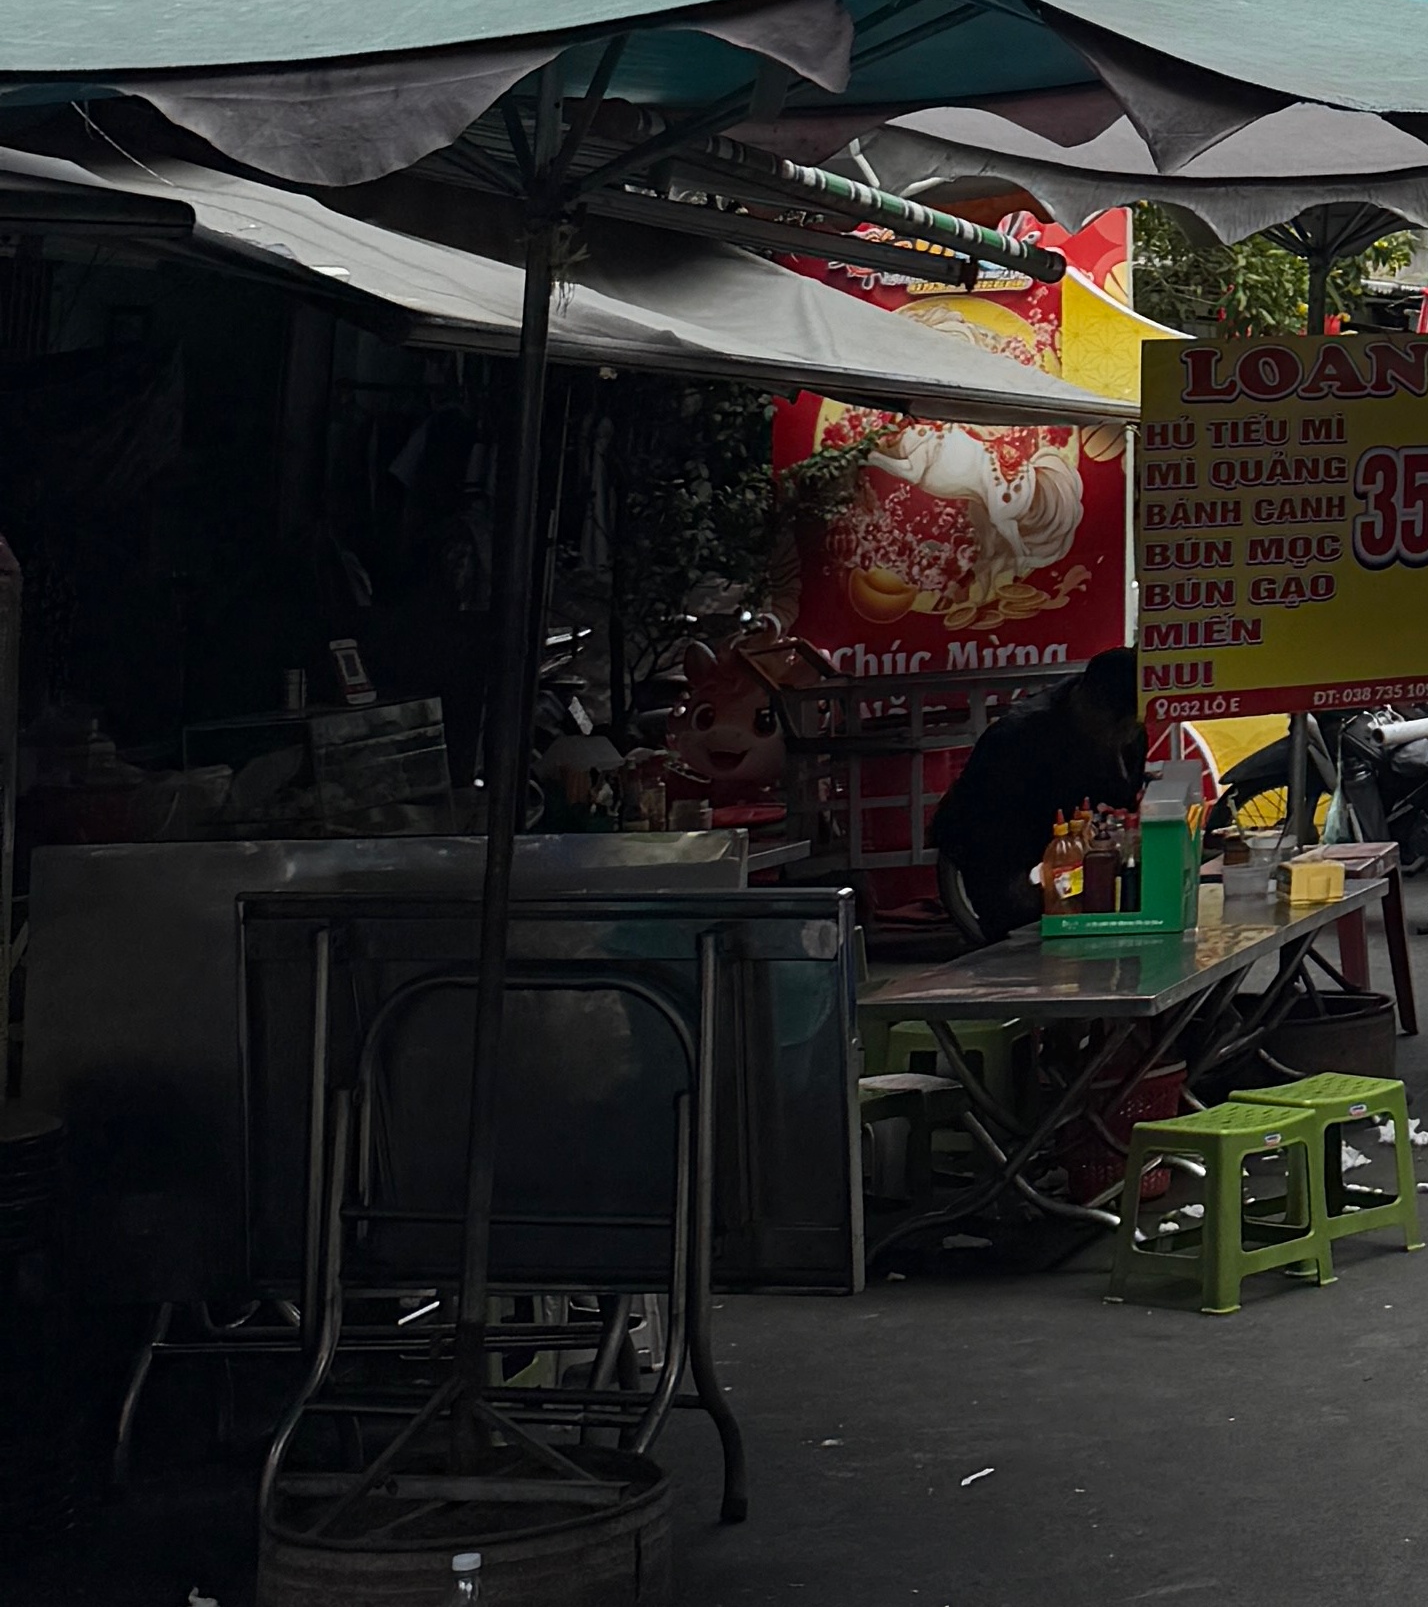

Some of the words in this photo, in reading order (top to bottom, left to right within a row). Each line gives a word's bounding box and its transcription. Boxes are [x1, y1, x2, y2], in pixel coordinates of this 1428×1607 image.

[1146, 414, 1196, 450] HỦ
[1206, 411, 1290, 446] TIỂU
[1299, 412, 1348, 443] MÌ
[1145, 456, 1197, 490] MÌ
[1210, 451, 1349, 488] QUẢNG
[1144, 496, 1242, 530] BÁNH
[1252, 494, 1346, 523] CANH
[1143, 536, 1235, 570] BÚN
[1247, 533, 1343, 567] MỌC
[1143, 577, 1236, 611] BÚN
[1249, 573, 1337, 608] GẠO
[1141, 660, 1214, 692] NUI
[1169, 700, 1200, 717] 032
[1204, 696, 1227, 714] LÔ
[1230, 697, 1241, 713] E
[1313, 691, 1340, 706] ĐT:
[1342, 688, 1372, 703] 038
[1374, 684, 1404, 701] 735
